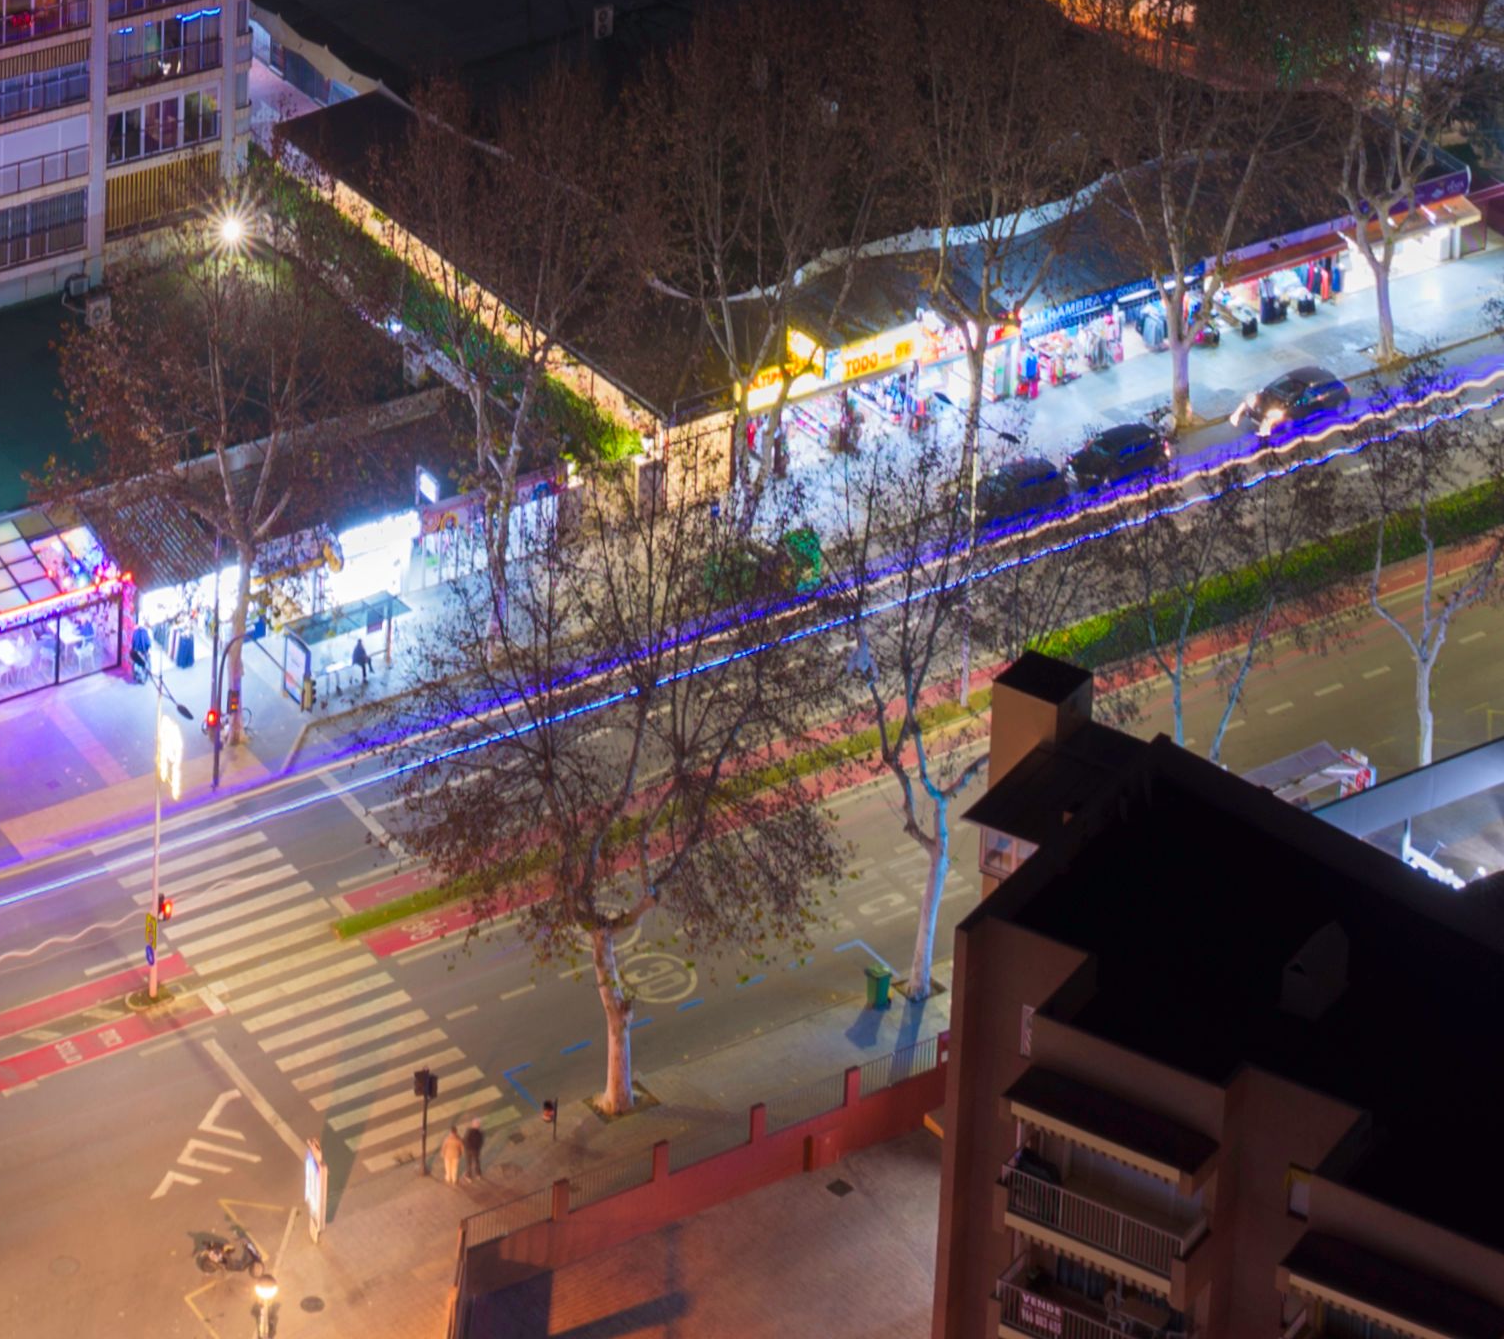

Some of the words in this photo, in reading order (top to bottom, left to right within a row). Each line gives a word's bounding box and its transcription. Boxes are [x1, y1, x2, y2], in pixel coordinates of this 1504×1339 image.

[1028, 295, 1103, 324] ALHAMBRA
[845, 351, 879, 377] TODO
[1022, 1291, 1061, 1316] VENDE
